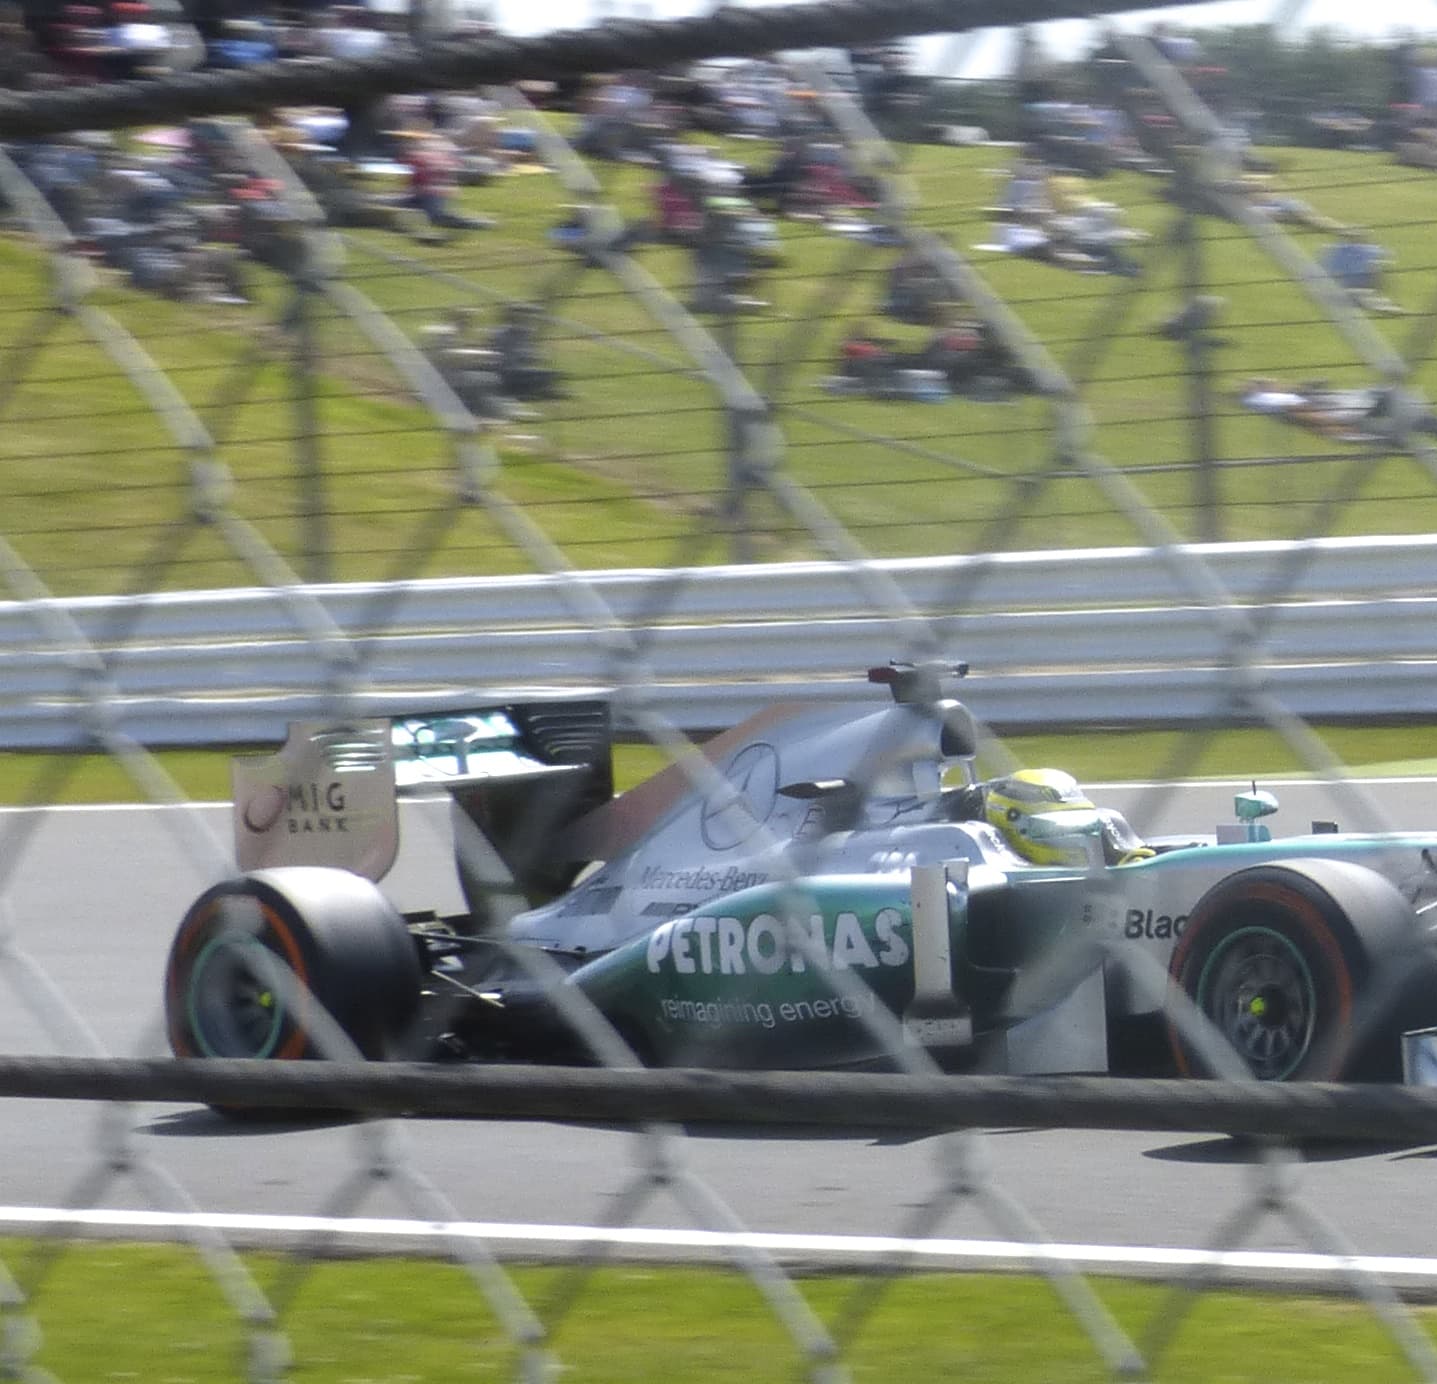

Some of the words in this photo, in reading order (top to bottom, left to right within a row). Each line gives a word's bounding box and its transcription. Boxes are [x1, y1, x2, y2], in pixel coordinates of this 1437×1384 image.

[287, 782, 345, 811] MIG
[288, 818, 351, 833] BANK
[647, 908, 909, 976] PETRONAS
